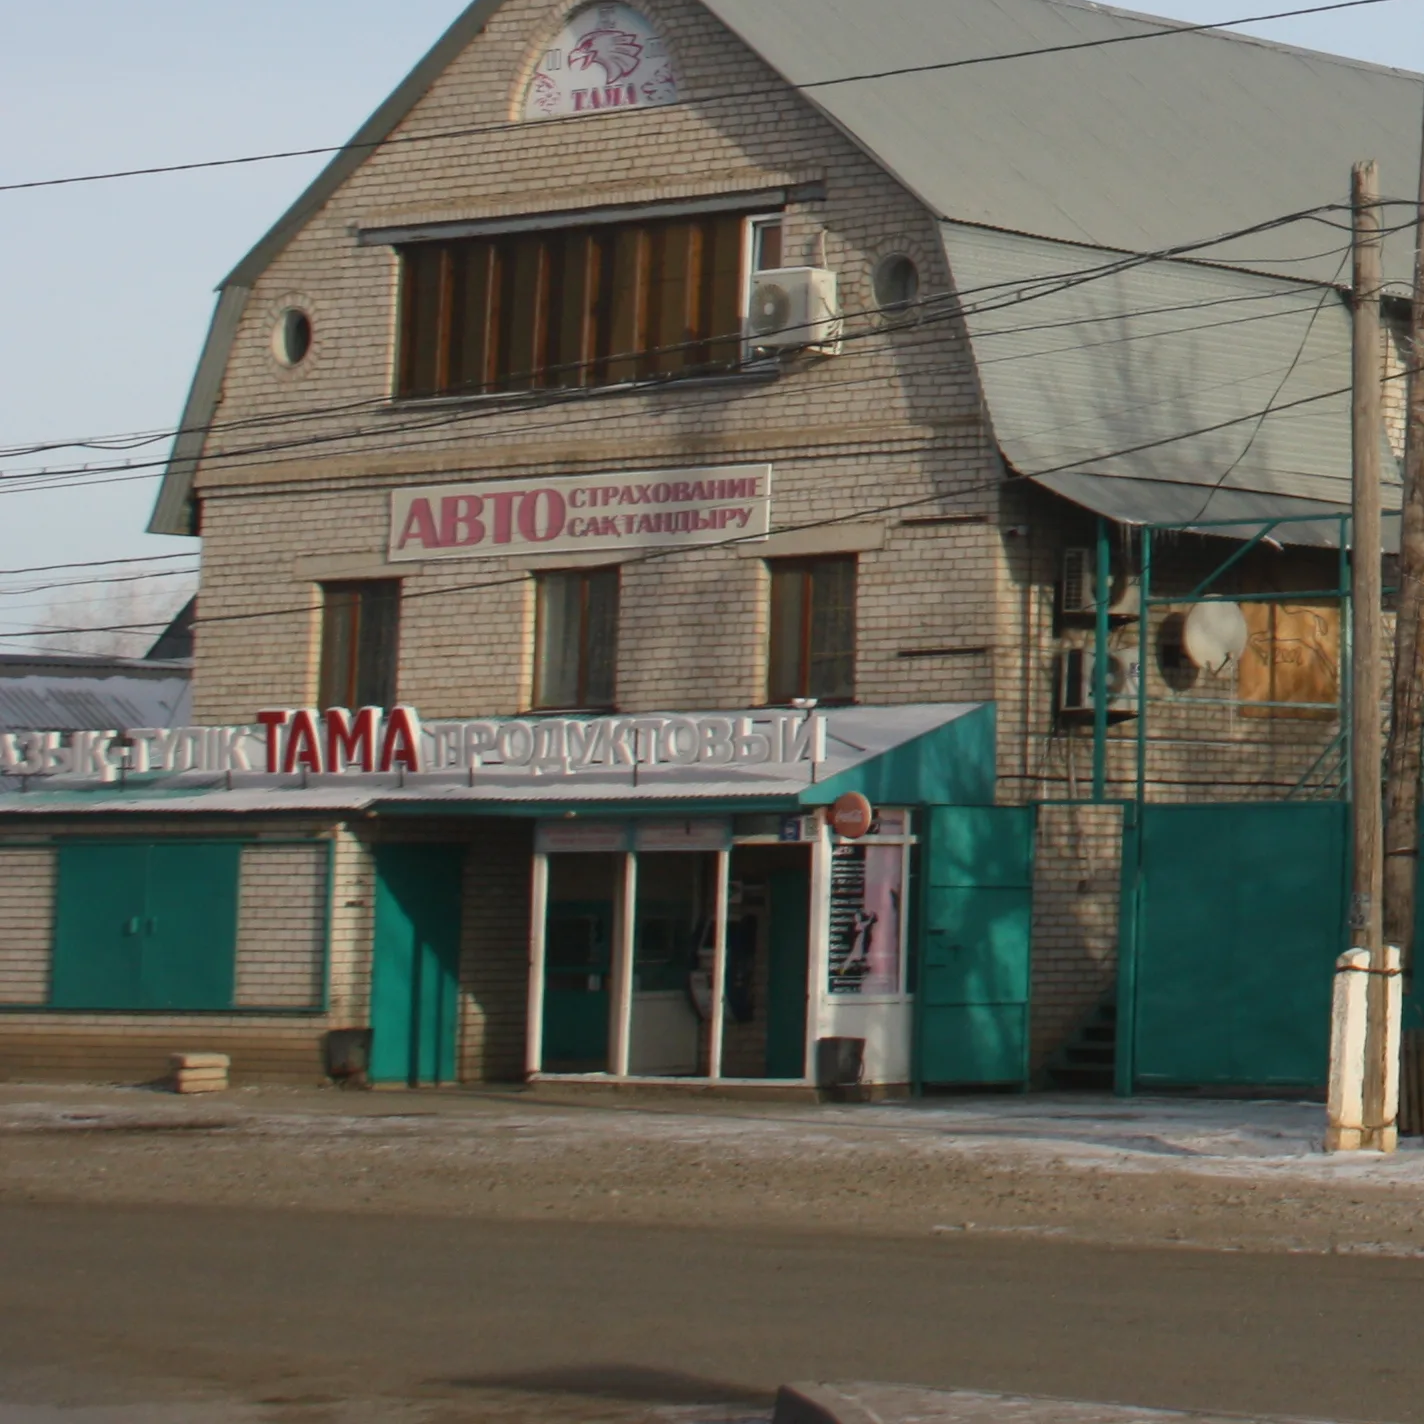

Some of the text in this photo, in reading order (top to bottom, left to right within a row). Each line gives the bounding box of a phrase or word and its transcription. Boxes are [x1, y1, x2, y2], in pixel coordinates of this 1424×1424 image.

[567, 477, 764, 508] СТРАХОВАНИЕ
[398, 488, 566, 550] АВТО
[567, 507, 754, 538] САҚТАНДЫРУ
[257, 706, 424, 774] ТАМА
[435, 698, 828, 775] ПРОДУКТОВЫЙ
